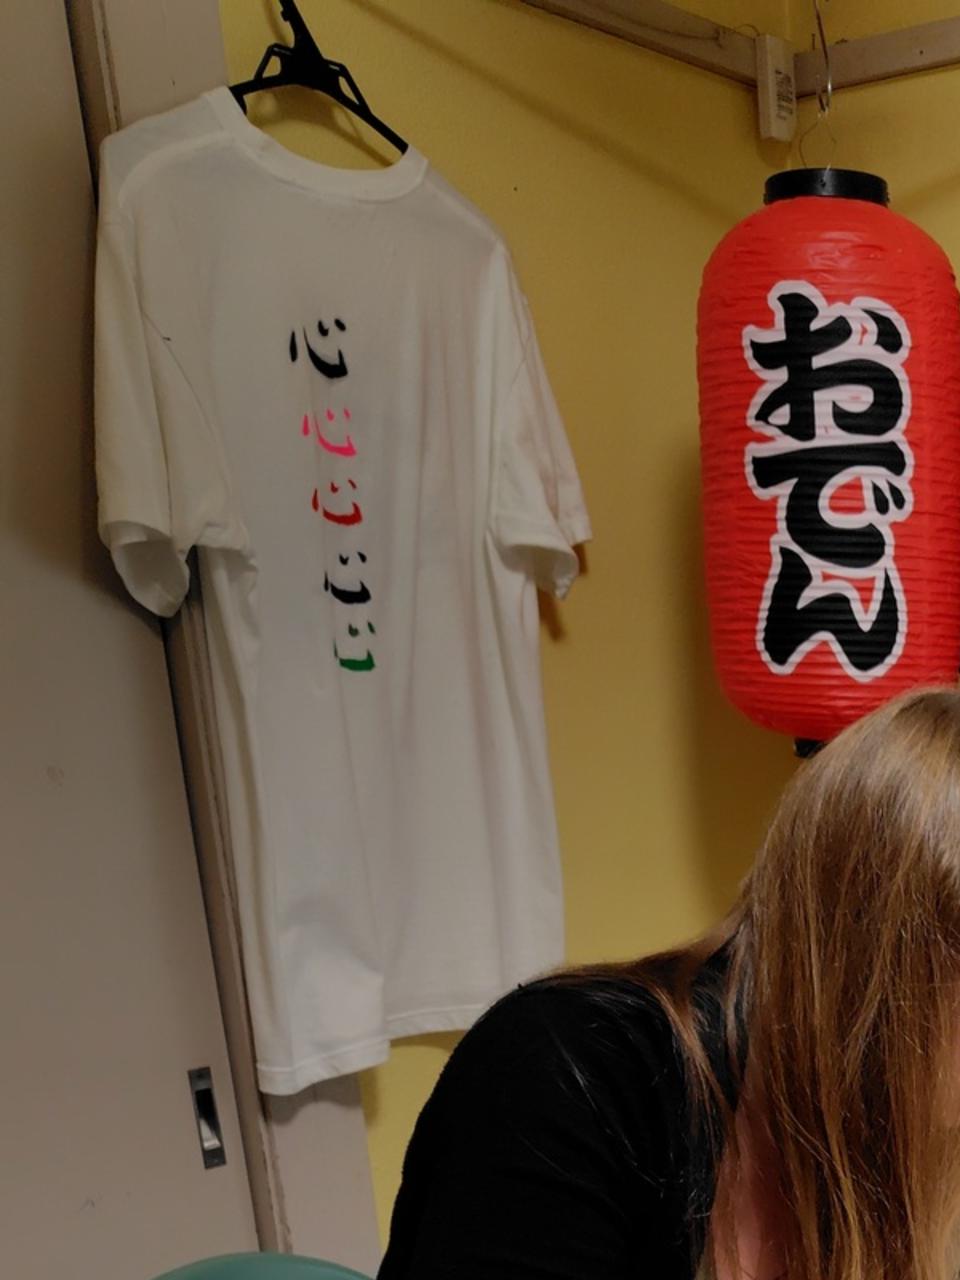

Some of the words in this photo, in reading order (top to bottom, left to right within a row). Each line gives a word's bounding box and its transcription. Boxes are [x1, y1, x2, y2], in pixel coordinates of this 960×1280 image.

[289, 318, 348, 379] 心
[302, 408, 357, 457] 心
[312, 478, 362, 525] 心
[744, 284, 912, 679] おでん
[324, 552, 371, 604] 心
[333, 621, 376, 671] 心
